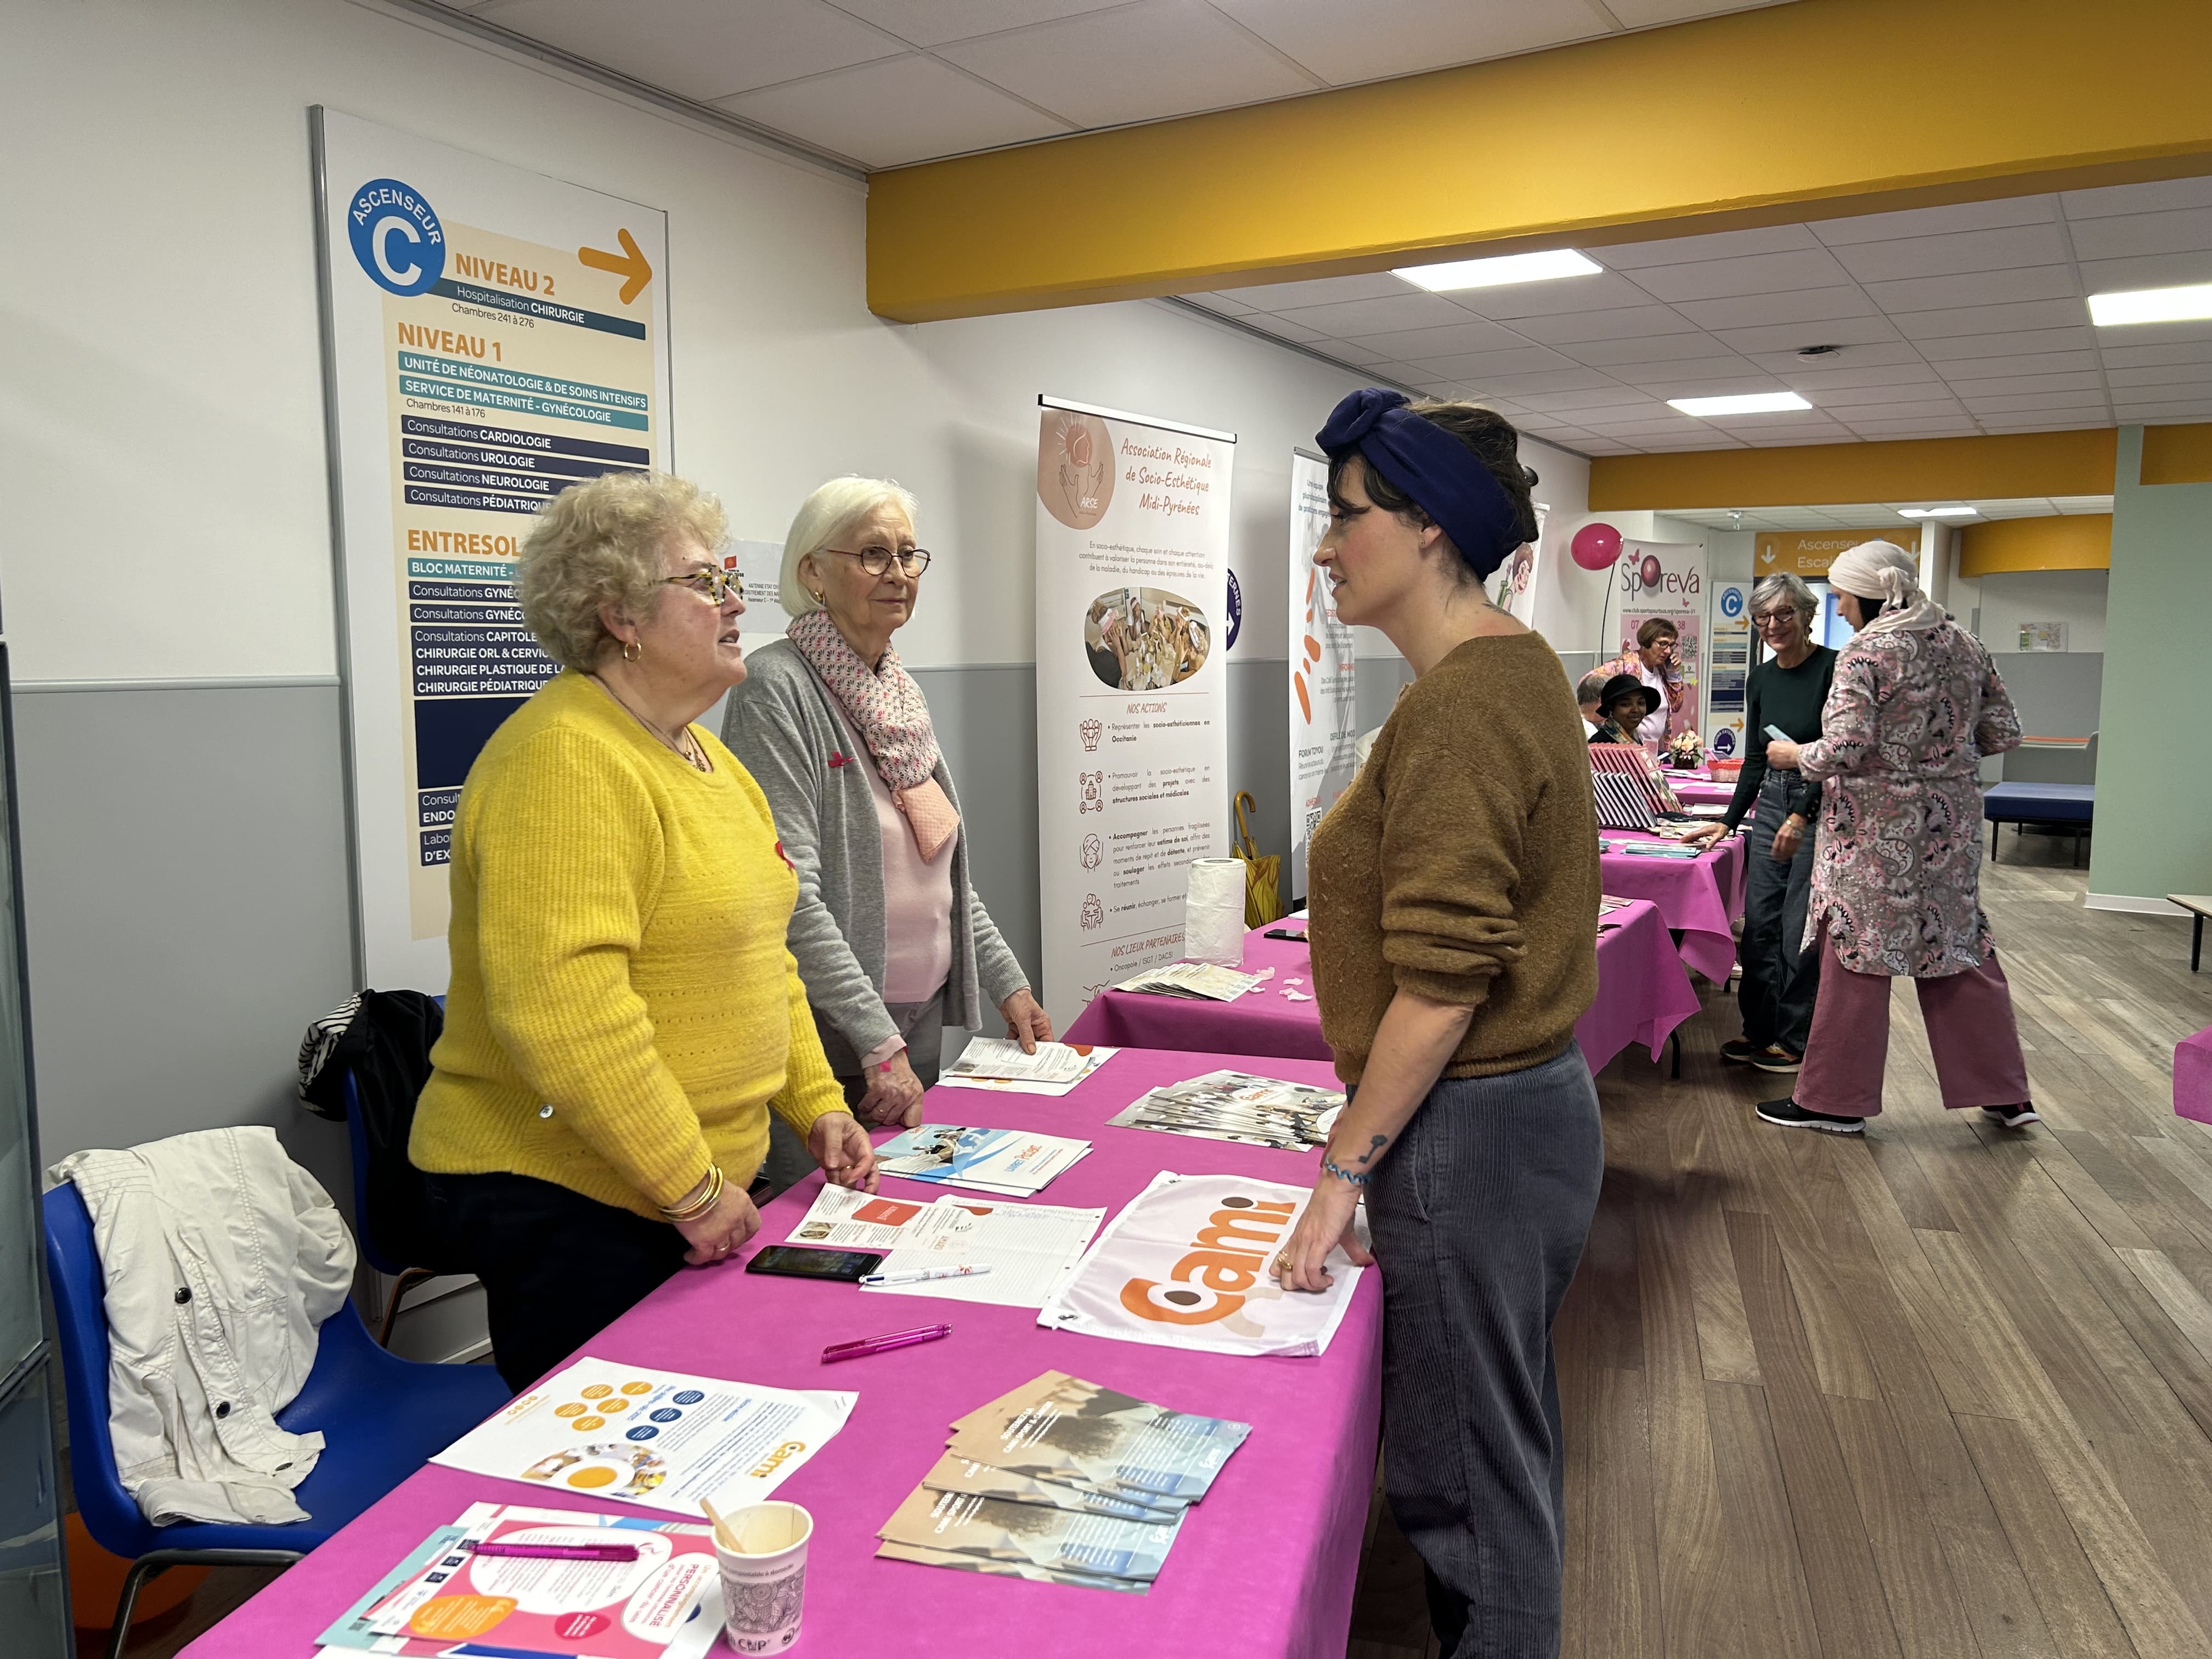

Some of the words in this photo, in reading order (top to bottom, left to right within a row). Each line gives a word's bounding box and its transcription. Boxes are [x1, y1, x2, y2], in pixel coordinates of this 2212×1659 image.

[353, 188, 441, 245] ASCENSEUR
[373, 216, 422, 286] C
[455, 253, 538, 291] NIVEAU
[543, 275, 555, 296] 2
[457, 285, 529, 311] Hospitalisation
[531, 303, 584, 323] CHIRURGIE
[452, 303, 496, 322] Chambres
[498, 313, 510, 324] 241
[513, 316, 518, 325] à
[520, 317, 534, 328] 276
[398, 322, 485, 358] NIVEAU
[493, 342, 501, 362] 1
[404, 356, 439, 373] UNITÉ
[442, 364, 456, 376] DE
[460, 364, 543, 391] NÉONATOLOGIE
[545, 381, 552, 392] &
[554, 383, 567, 394] DE
[569, 386, 597, 400] SOINS
[600, 391, 646, 408] INTENSIFS
[405, 380, 454, 397] SERVICE
[456, 388, 471, 400] DE
[473, 390, 534, 410] MATERNITÉ
[542, 400, 611, 422] GYNÉCOLOGIE
[407, 398, 450, 413] Chambres
[452, 405, 464, 414] 141
[465, 405, 471, 416] à
[472, 407, 485, 417] 176
[408, 420, 478, 439] Consultations
[480, 430, 551, 449] CARDIOLOGIE
[409, 443, 479, 461] Consultations
[481, 452, 535, 468] UROLOGIE
[1121, 438, 1171, 461] Association
[1174, 448, 1211, 469] Régionale
[409, 466, 480, 484] Consultations
[482, 474, 550, 490] NEUROLOGIE
[1126, 467, 1136, 481] de
[1139, 467, 1209, 494] Socio-Esthétique
[411, 490, 481, 506] Consultations
[1080, 497, 1098, 509] ARSE
[1139, 494, 1200, 516] Midi-Pyrénées
[408, 529, 521, 556] ENTRESOL
[1169, 549, 1184, 557] chaque
[412, 562, 443, 574] BLOC
[445, 563, 506, 576] MATERNITÉ
[1130, 567, 1150, 576] handicap
[413, 585, 483, 599] Consultations
[1725, 595, 1737, 613] C
[414, 607, 484, 619] Consultations
[486, 607, 525, 620] GYNÉC
[1631, 620, 1639, 629] 07
[415, 630, 485, 642] Consultations
[486, 631, 538, 642] CAPITOLE
[416, 648, 476, 659] CHIRURGIE
[478, 648, 500, 658] ORL
[502, 648, 509, 658] &
[417, 665, 478, 675] CHIRURGIE
[479, 663, 538, 675] PLASTIQUE
[539, 664, 552, 674] DE
[417, 682, 478, 693] CHIRURGIE
[1127, 703, 1139, 714] NOS
[1141, 702, 1167, 713] ACTIONS
[1112, 723, 1139, 732] Représenter
[1113, 783, 1141, 792] développant
[1163, 780, 1178, 788] projets
[1139, 792, 1159, 800] sociales
[1166, 789, 1189, 797] médicales
[423, 810, 455, 823] ENDO
[424, 833, 452, 845] Labo
[1113, 831, 1148, 840] Accompagner
[1163, 825, 1184, 835] personnes
[1113, 856, 1134, 864] moments
[1143, 851, 1153, 860] répit
[1193, 844, 1210, 853] prévenir
[1123, 866, 1144, 875] soulager
[1114, 879, 1139, 889] traitements
[1111, 945, 1125, 958] NOS
[1126, 941, 1144, 954] LIEUX
[1146, 931, 1186, 949] PARTENAIRES
[1114, 962, 1138, 971] Oncopole
[1159, 951, 1172, 961] DAC31
[1120, 1197, 1296, 1325] Cami
[749, 1441, 806, 1477] Cami
[650, 1564, 699, 1627] PERSONNALISÉ
